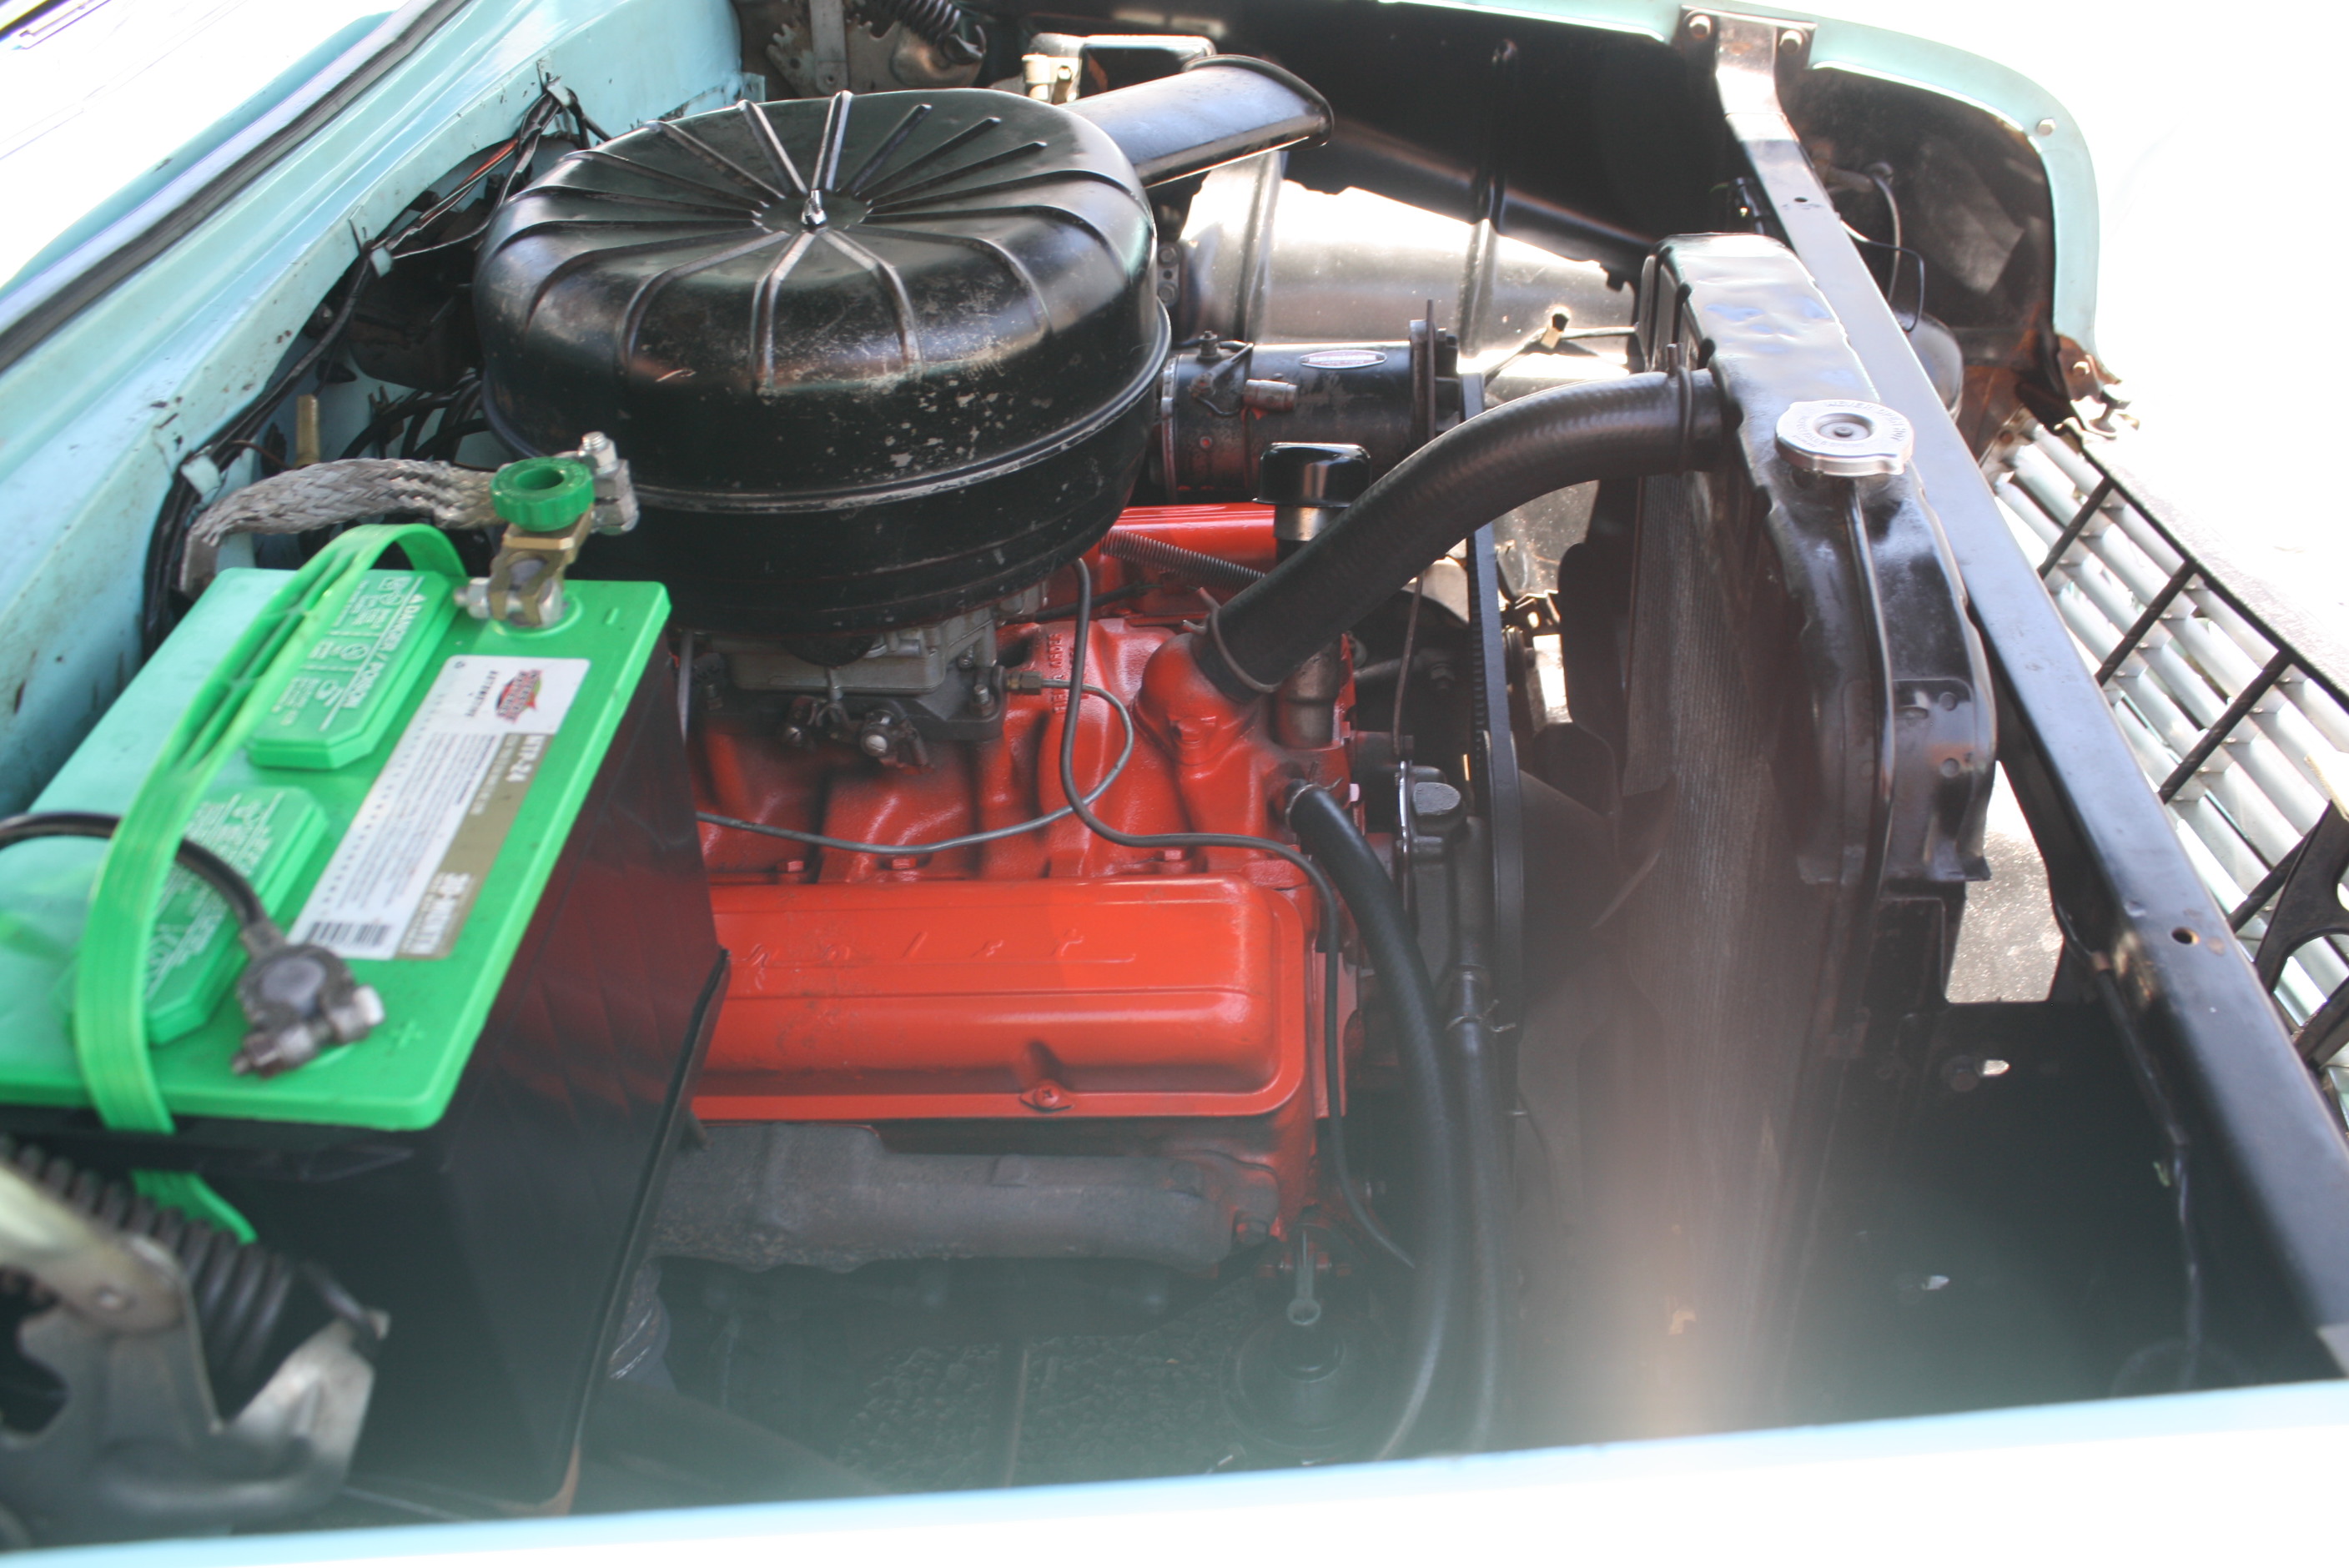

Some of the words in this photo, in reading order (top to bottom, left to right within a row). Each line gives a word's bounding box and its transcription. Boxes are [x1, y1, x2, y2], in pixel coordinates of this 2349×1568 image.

[376, 604, 423, 651] DANGER
[342, 661, 386, 708] POISON
[496, 671, 529, 718] BATTERIES
[505, 669, 541, 724] INTERSTATE
